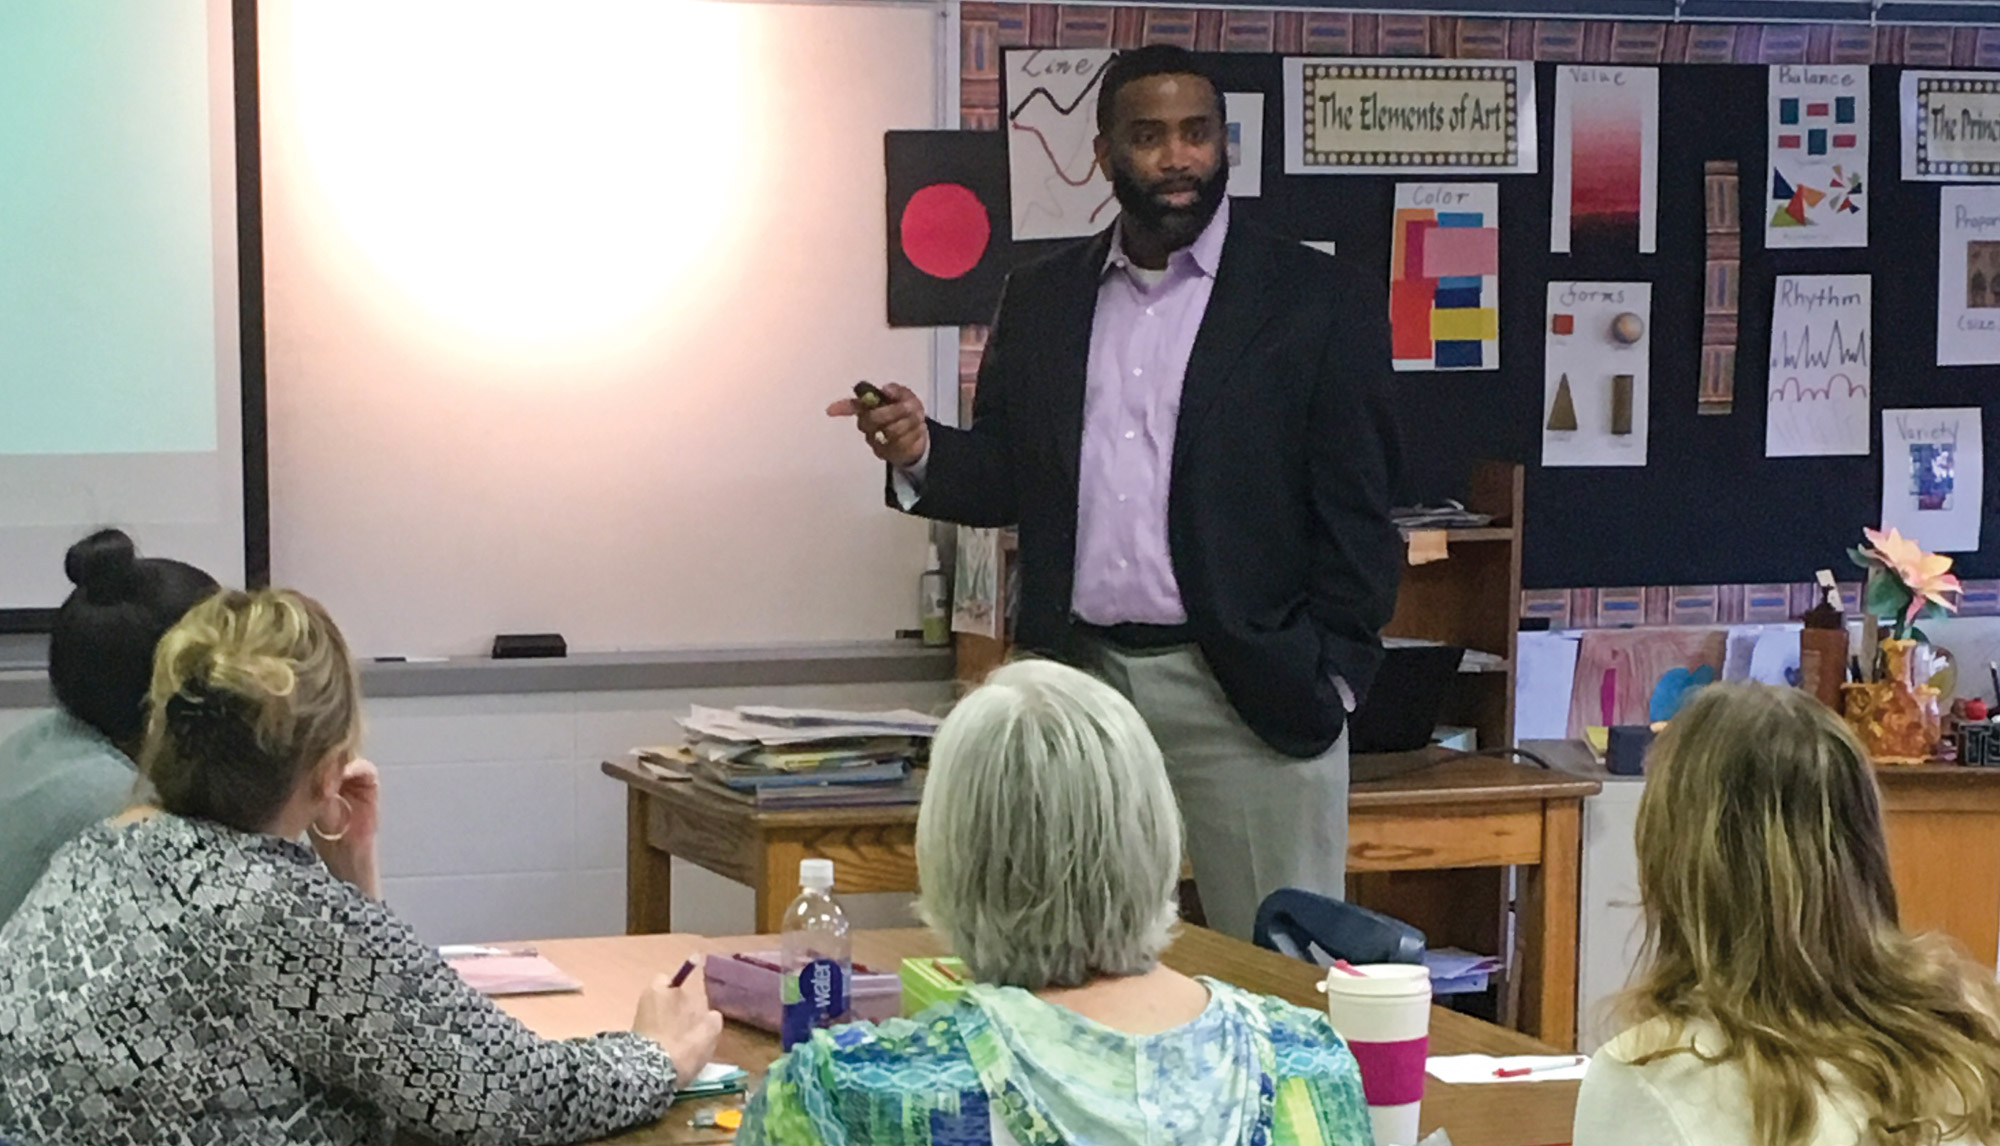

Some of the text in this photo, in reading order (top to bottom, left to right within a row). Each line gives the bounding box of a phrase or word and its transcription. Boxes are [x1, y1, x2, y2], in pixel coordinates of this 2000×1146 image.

[1021, 50, 1093, 77] Line
[1568, 67, 1626, 86] Value
[1778, 66, 1855, 87] Balance
[1318, 91, 1503, 132] The Elements of Art
[1931, 104, 1957, 141] The
[1412, 185, 1469, 206] Color
[1781, 279, 1861, 313] Rhythm
[1896, 414, 1959, 446] Variety
[811, 963, 831, 1008] water
